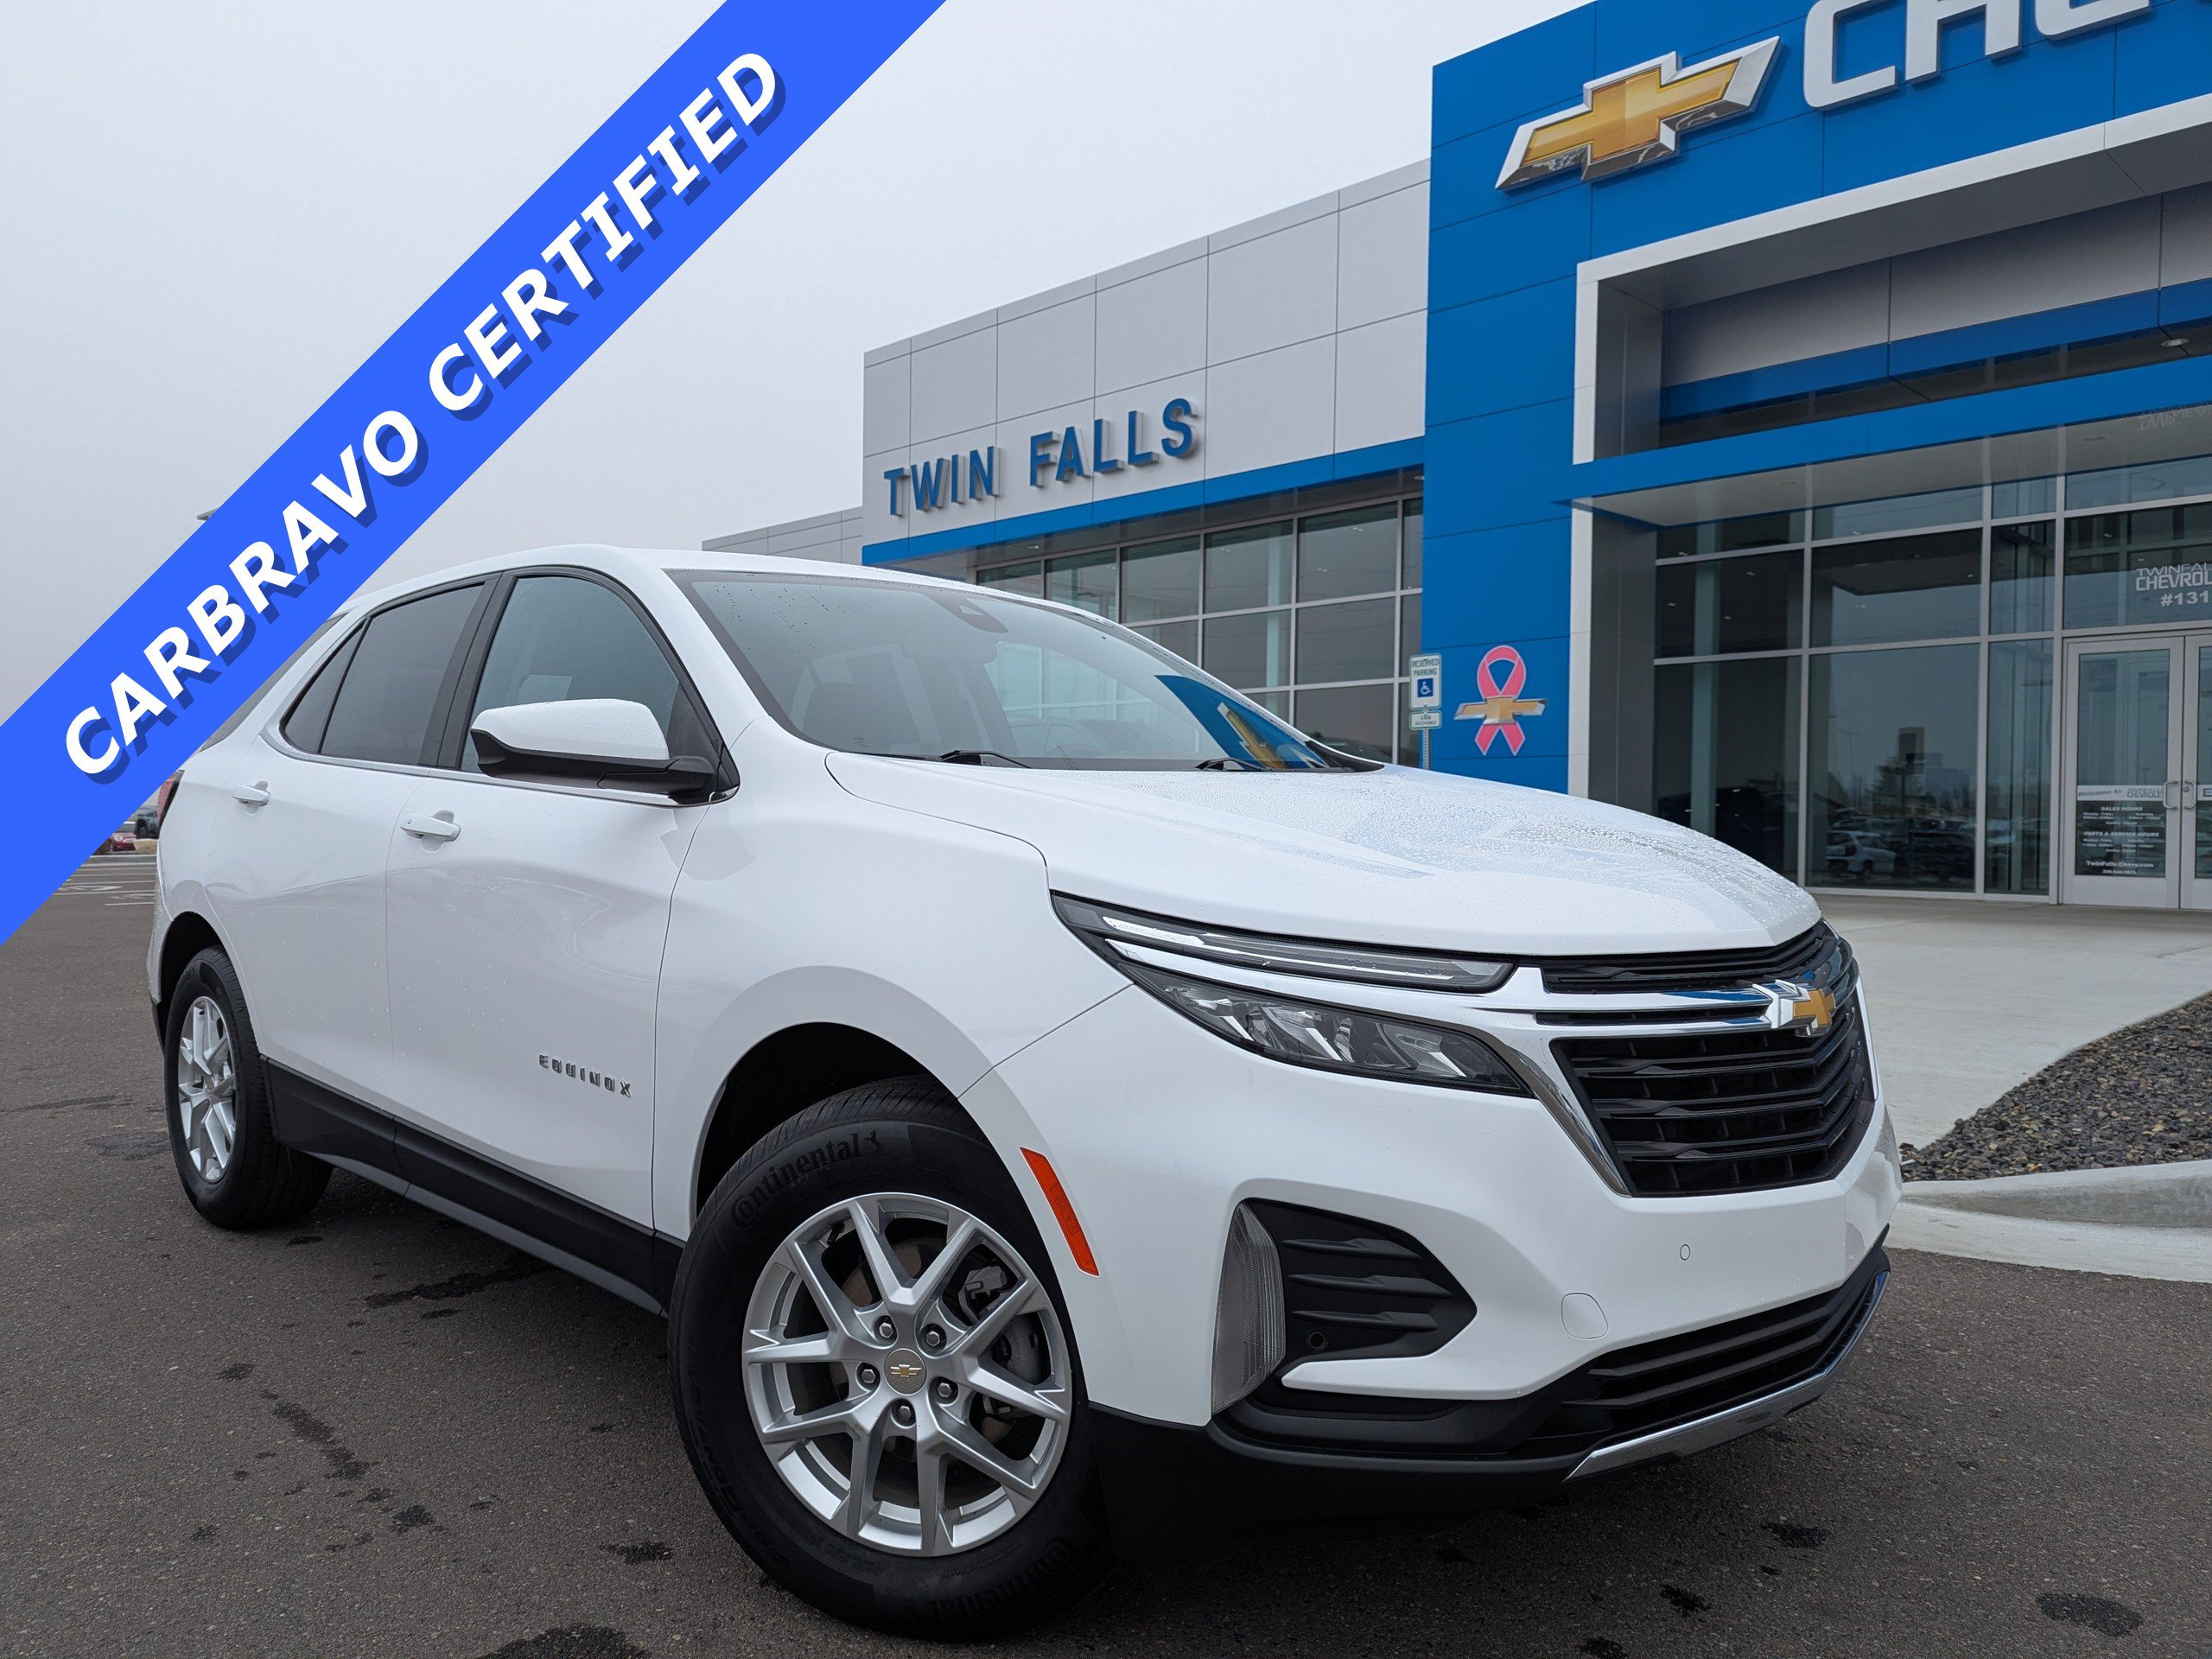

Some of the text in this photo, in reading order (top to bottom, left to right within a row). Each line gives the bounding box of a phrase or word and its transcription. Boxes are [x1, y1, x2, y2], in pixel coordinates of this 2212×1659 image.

[884, 398, 1199, 517] TWIN FALLS
[1411, 658, 1440, 668] RESERVED
[1413, 667, 1438, 677] PARKING
[538, 1053, 632, 1098] EQUINOX
[731, 1133, 860, 1228] Continental
